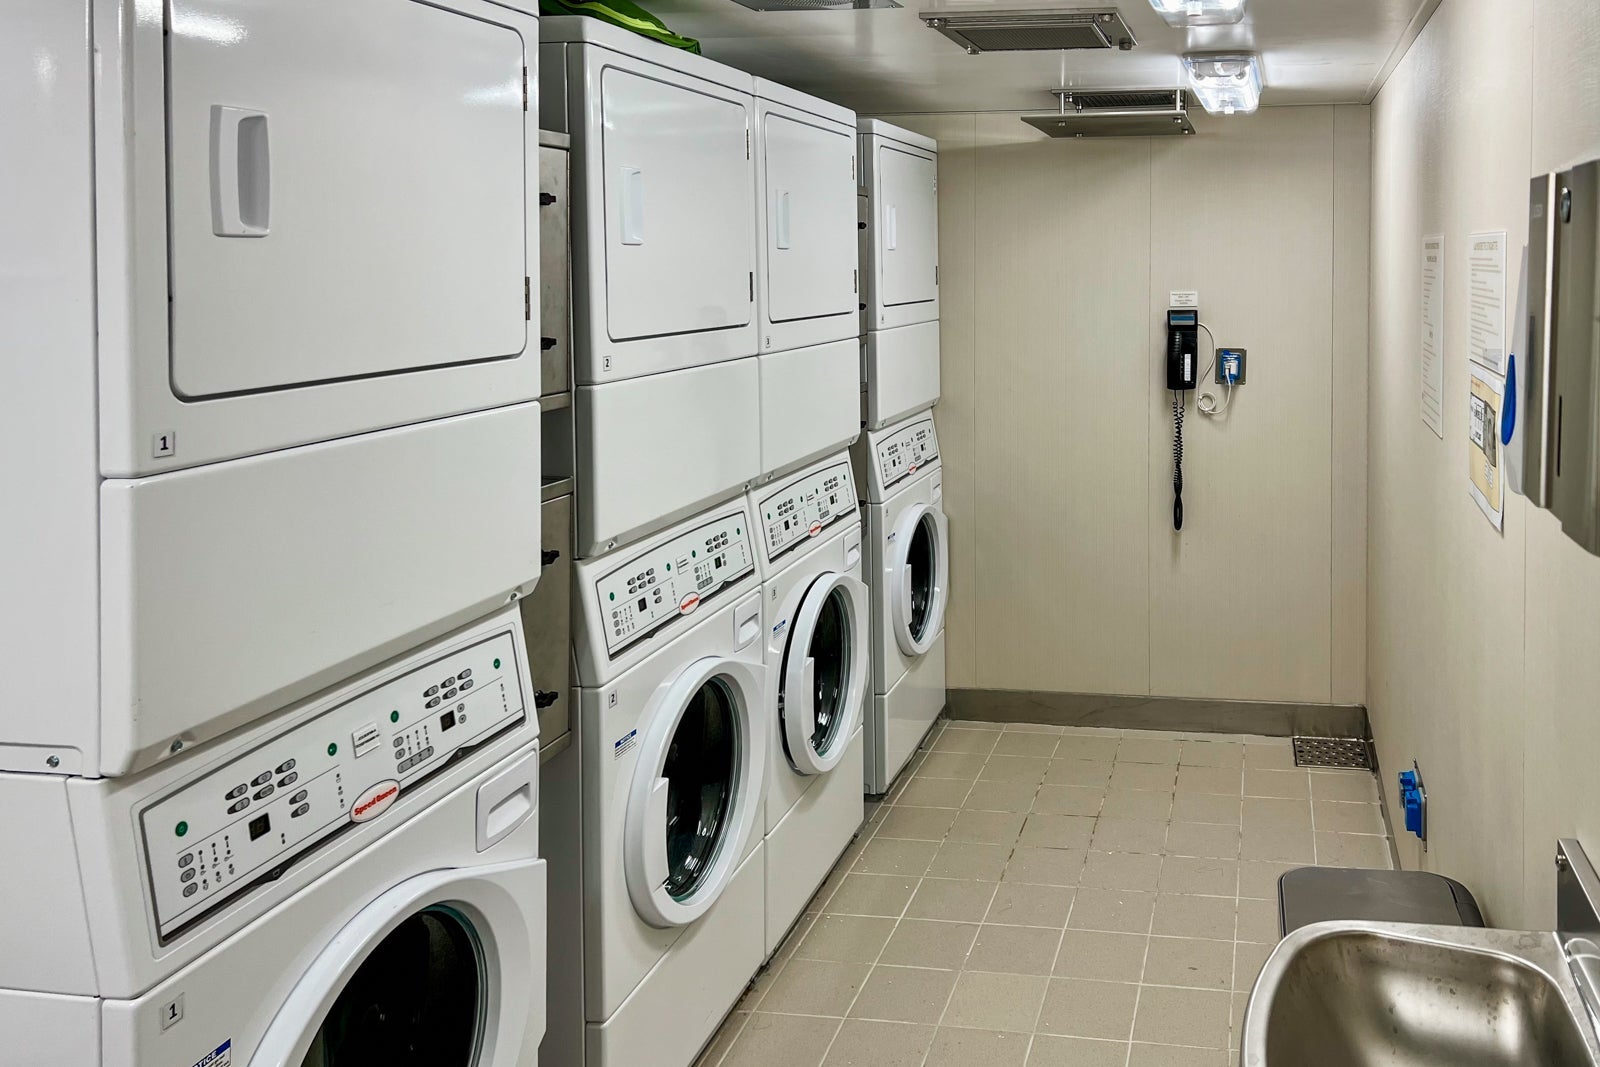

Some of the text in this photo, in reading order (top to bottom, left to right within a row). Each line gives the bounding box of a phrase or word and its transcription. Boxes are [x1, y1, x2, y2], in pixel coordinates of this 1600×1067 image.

[605, 358, 610, 368] 2
[160, 435, 169, 451] 1
[610, 693, 615, 704] 2
[354, 786, 397, 816] Speed Queen
[169, 1003, 178, 1020] 1
